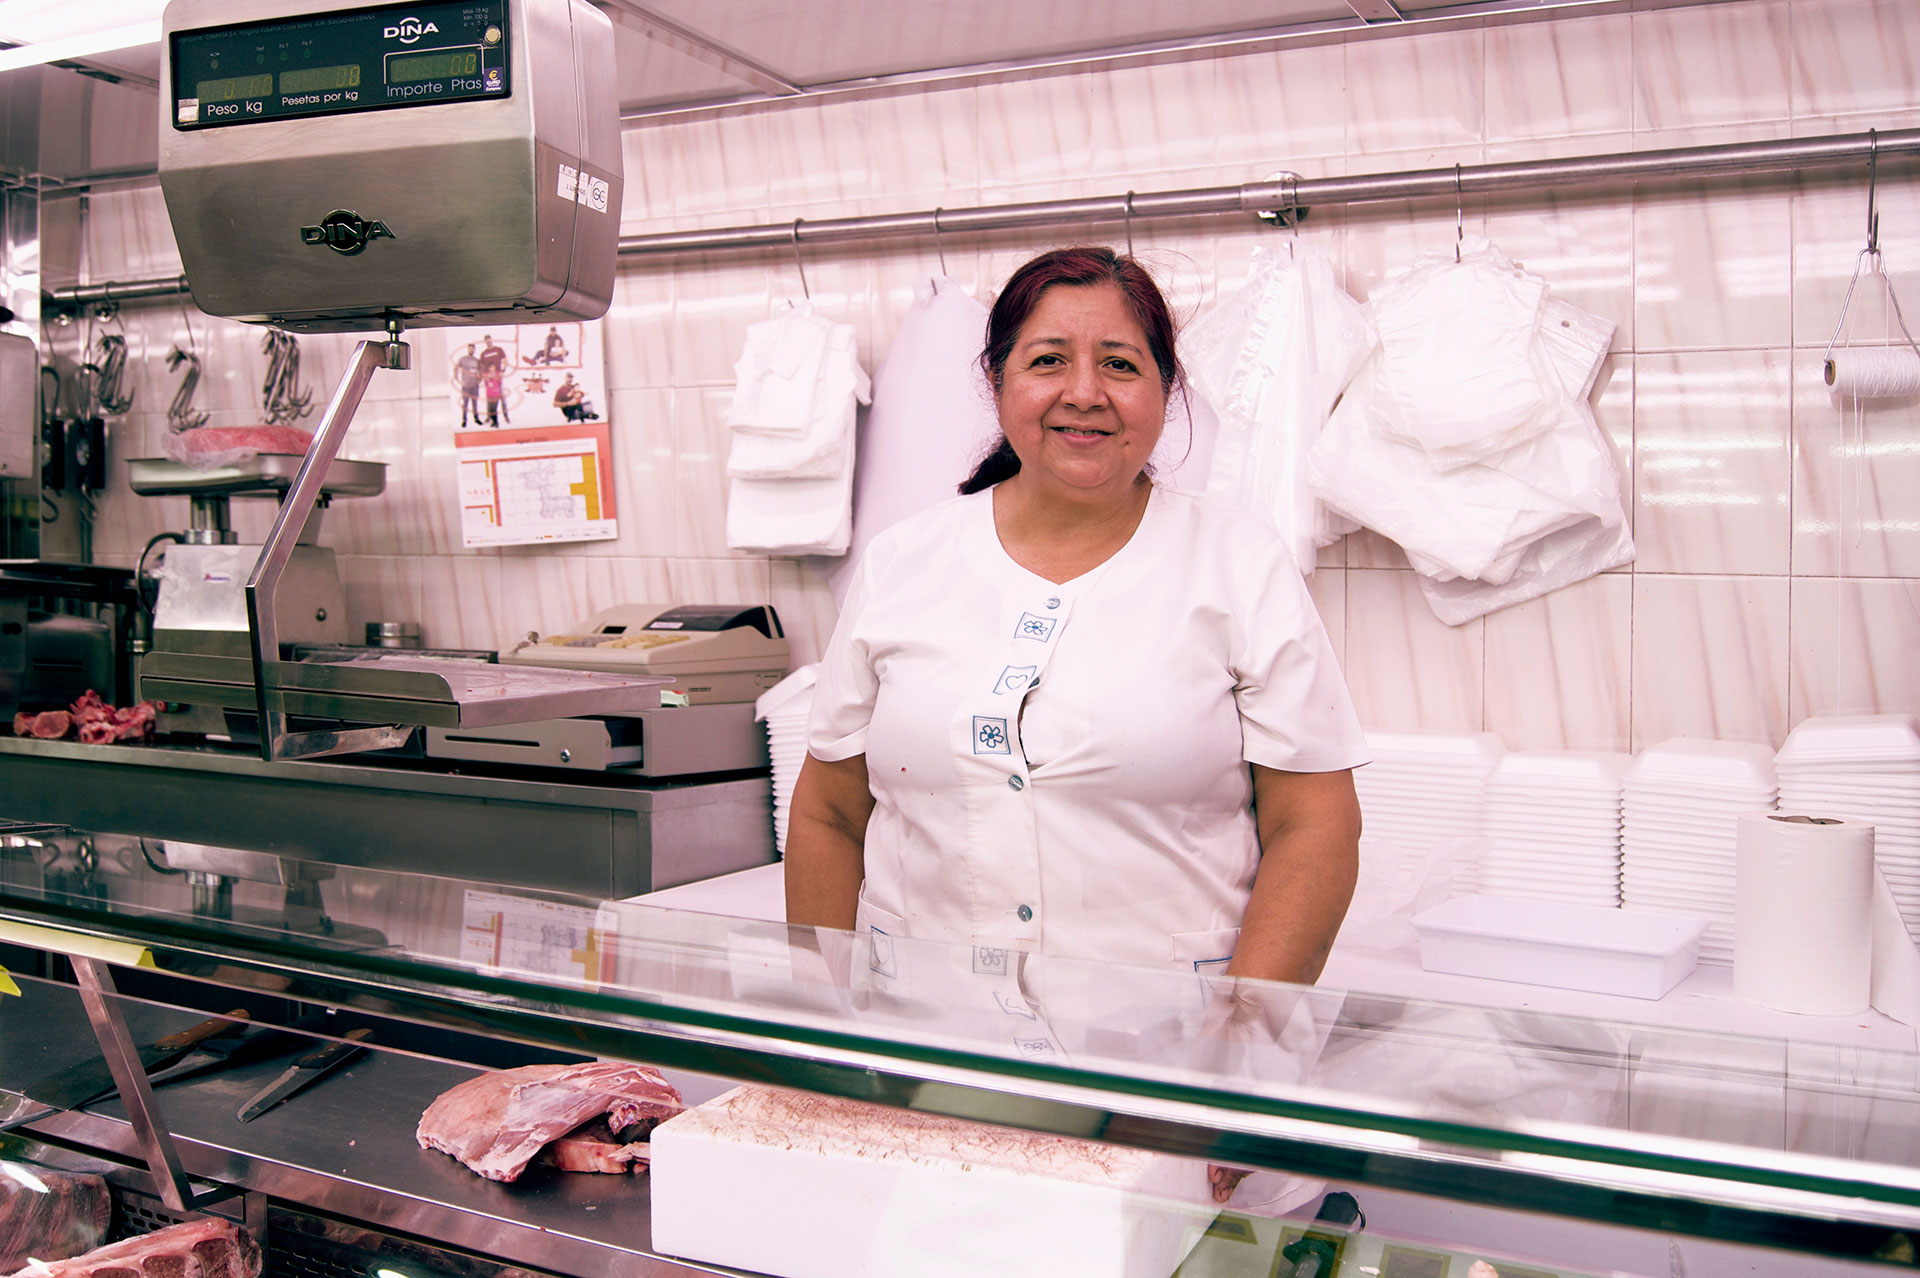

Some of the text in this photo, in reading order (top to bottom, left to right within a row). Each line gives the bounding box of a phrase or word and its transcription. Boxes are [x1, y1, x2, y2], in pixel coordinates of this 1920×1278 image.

[383, 21, 440, 39] DINA
[386, 78, 482, 98] Importe Ptas
[281, 89, 359, 107] Pesetas por kg
[207, 99, 263, 117] Peso kg
[300, 217, 397, 245] DINA
